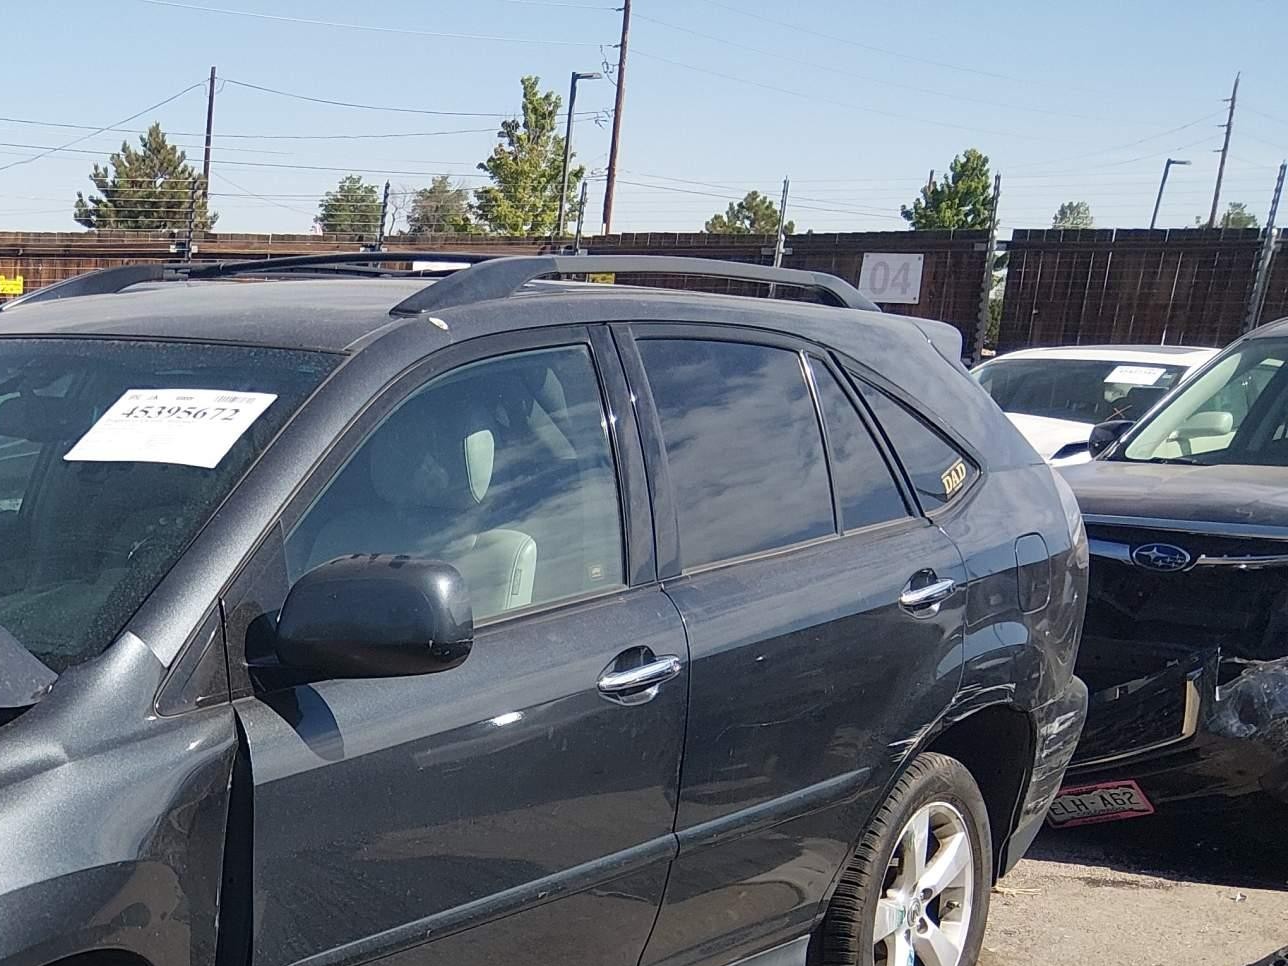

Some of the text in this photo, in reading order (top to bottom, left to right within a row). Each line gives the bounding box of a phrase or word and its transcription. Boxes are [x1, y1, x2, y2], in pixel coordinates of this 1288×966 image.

[870, 261, 911, 295] 04
[121, 405, 241, 422] 45395672
[942, 462, 967, 495] DAD
